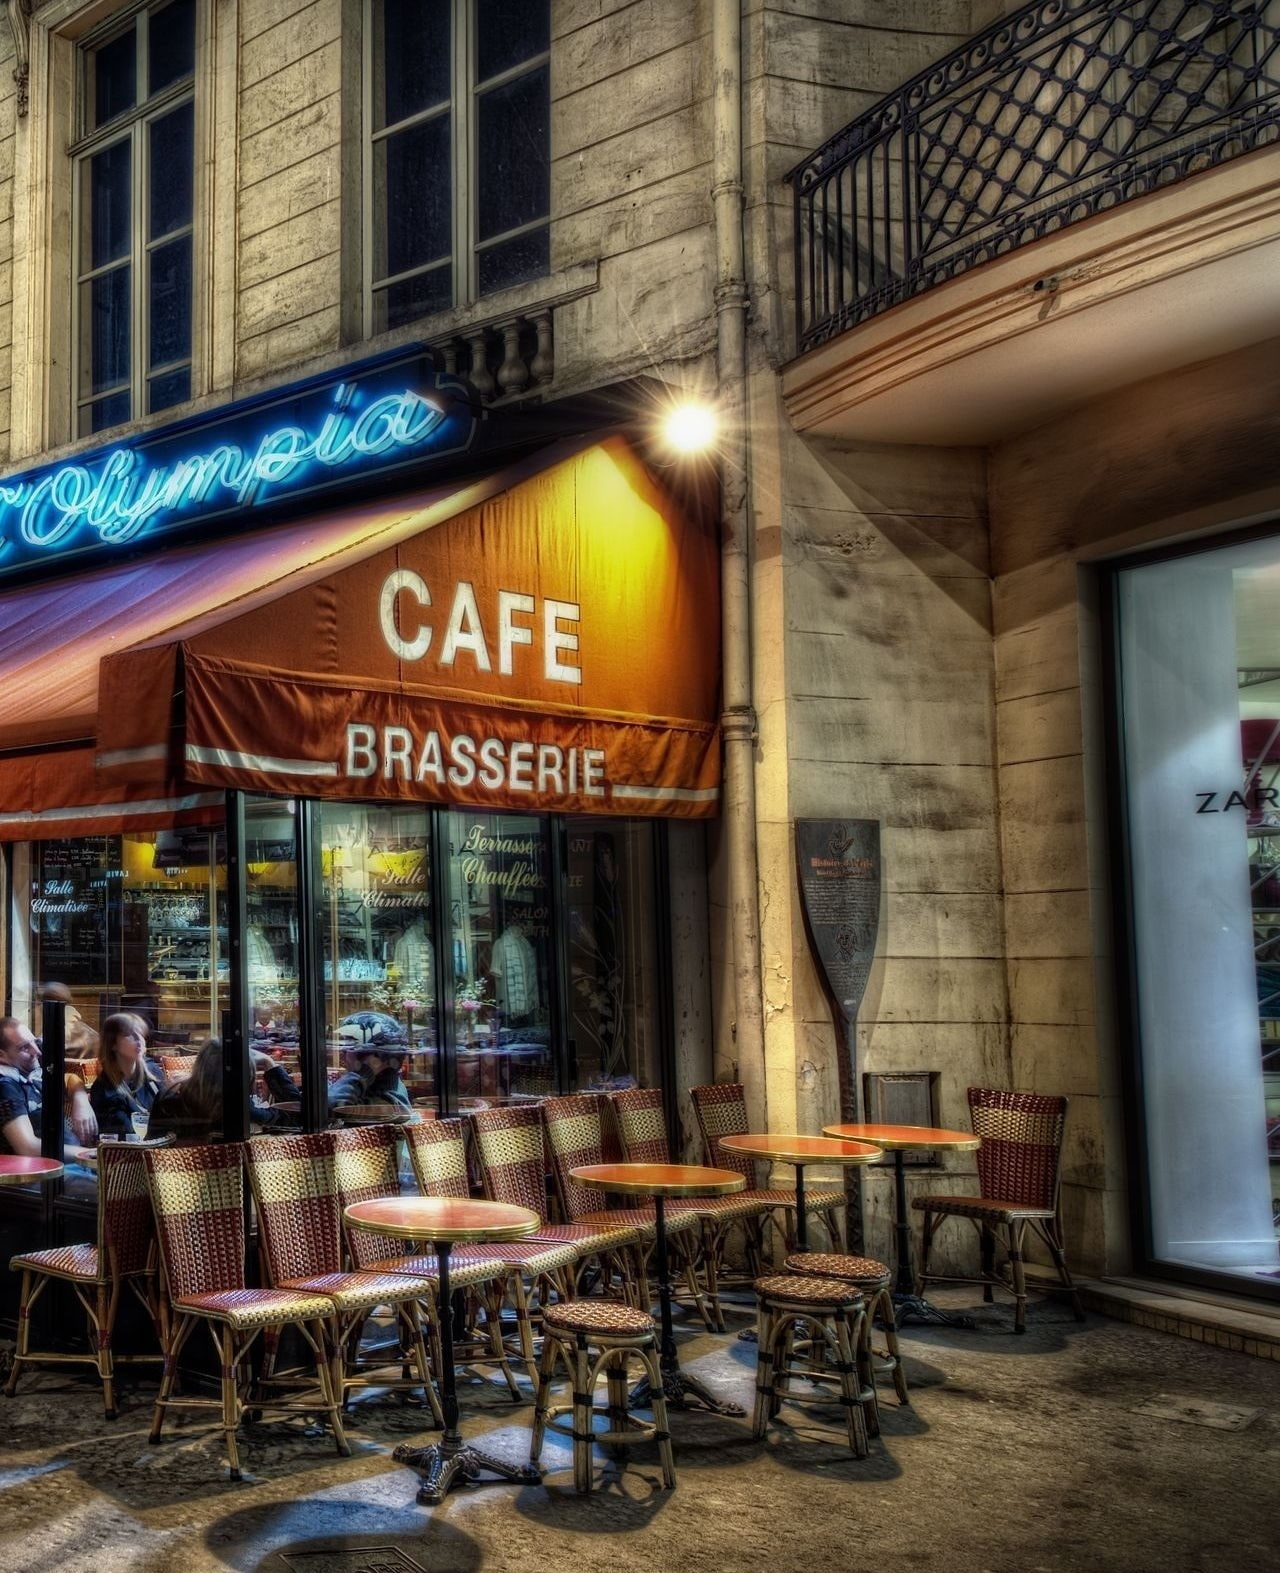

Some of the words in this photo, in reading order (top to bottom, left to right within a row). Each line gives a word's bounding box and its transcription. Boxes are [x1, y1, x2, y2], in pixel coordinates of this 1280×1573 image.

[378, 567, 583, 686] CAFE
[345, 722, 606, 797] BRASSERIE
[466, 824, 534, 855] Terrasse
[44, 879, 74, 896] Salle
[381, 868, 426, 886] Salle
[31, 898, 89, 914] Climatisée
